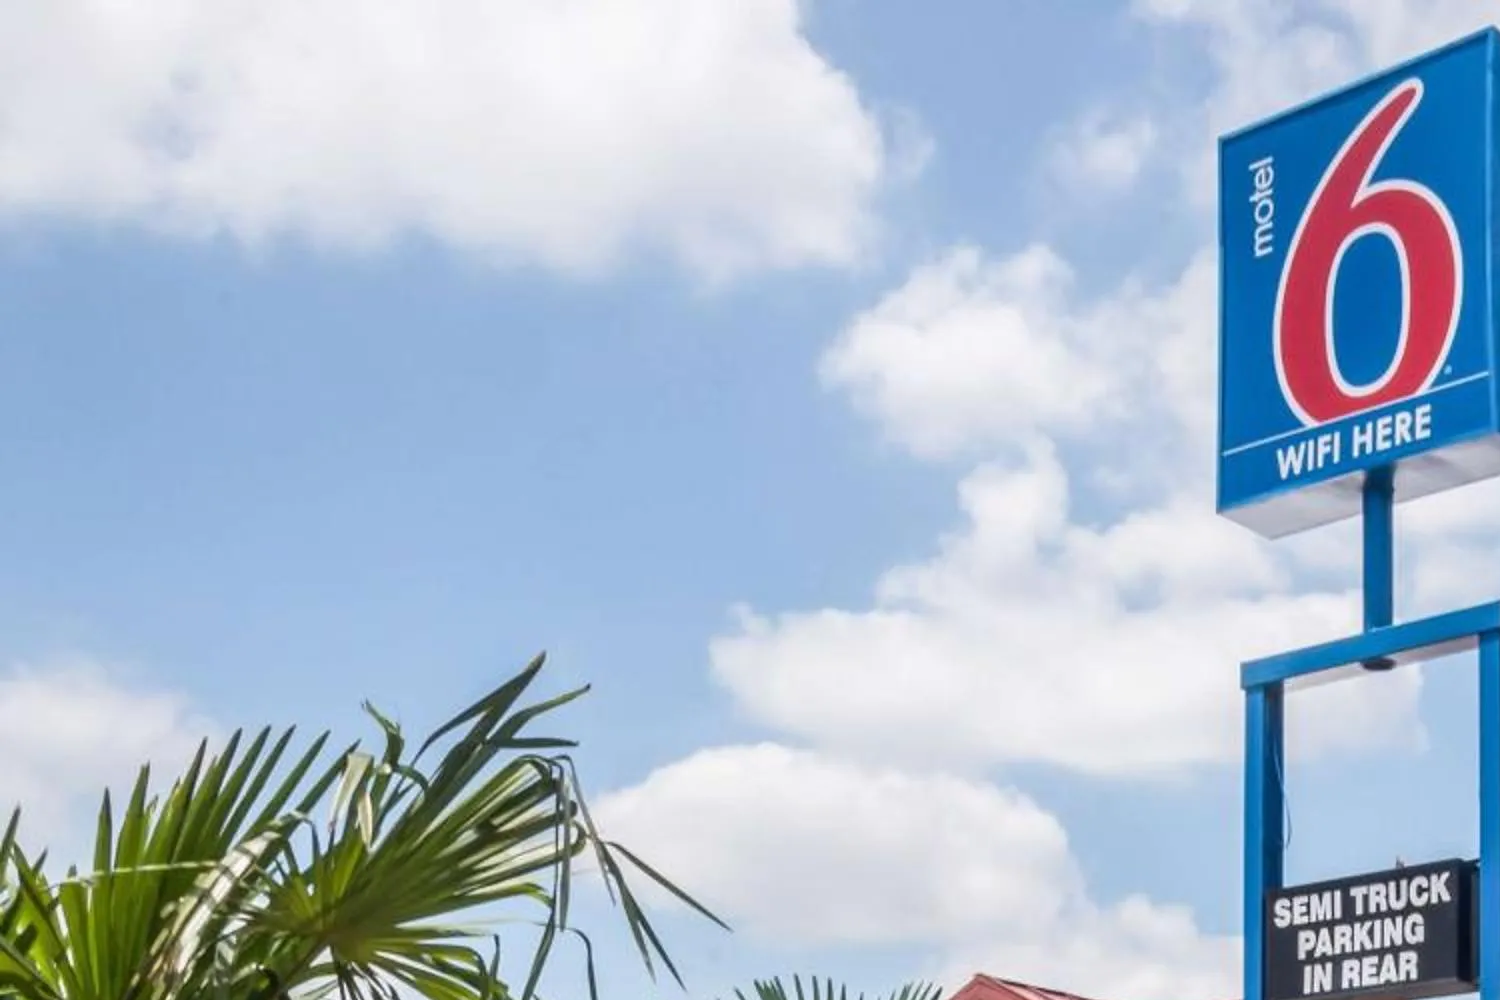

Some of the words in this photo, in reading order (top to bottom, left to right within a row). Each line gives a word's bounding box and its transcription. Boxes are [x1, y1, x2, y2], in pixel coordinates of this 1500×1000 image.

[1249, 156, 1274, 257] motel
[1273, 77, 1464, 428] 6
[1276, 431, 1340, 481] WIFI
[1352, 404, 1432, 459] HERE
[1273, 889, 1342, 928] SEMI
[1350, 871, 1451, 916] TRUCK
[1297, 912, 1425, 960] PARKING
[1303, 962, 1333, 995] IN
[1341, 951, 1419, 989] REAR
